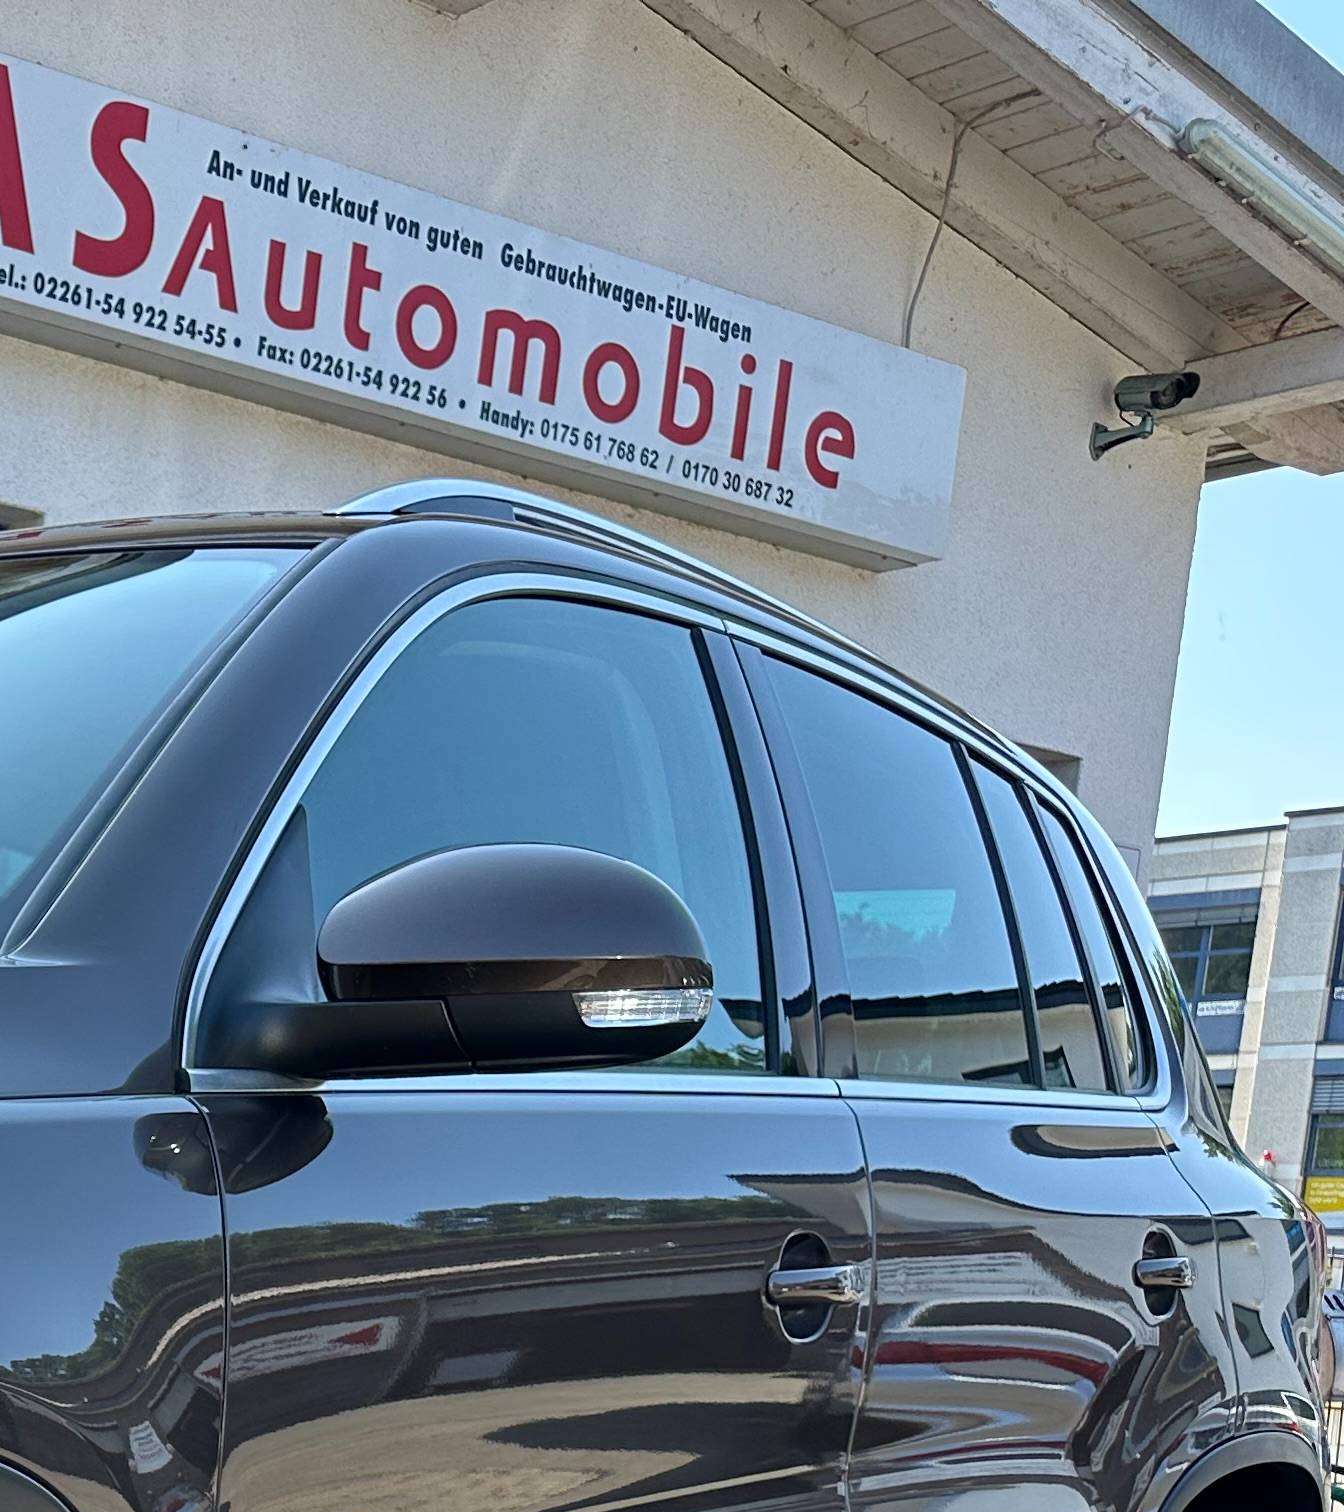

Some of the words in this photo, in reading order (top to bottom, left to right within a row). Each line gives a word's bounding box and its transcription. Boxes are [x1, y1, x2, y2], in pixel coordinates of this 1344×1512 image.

[207, 149, 243, 181] An-
[250, 168, 290, 198] und
[297, 177, 379, 226] Verkauf
[385, 211, 420, 239] von
[426, 225, 484, 260] guten
[500, 243, 753, 343] Gebrauchtwagen-EU-Wagen
[33, 272, 125, 319] 02261-54
[132, 302, 168, 332] 922
[173, 315, 226, 348] 54-55
[258, 335, 294, 365] Fax:
[300, 348, 383, 390] 02261-54
[389, 374, 421, 402] 922
[426, 385, 448, 408] 56
[479, 400, 534, 437] Handy:
[540, 418, 579, 447] 0175
[583, 431, 602, 453] 61
[608, 437, 636, 462] 768
[640, 446, 660, 469] 62
[682, 458, 719, 486] 0170
[722, 469, 741, 493] 30
[745, 476, 772, 504] 687
[775, 486, 795, 508] 32
